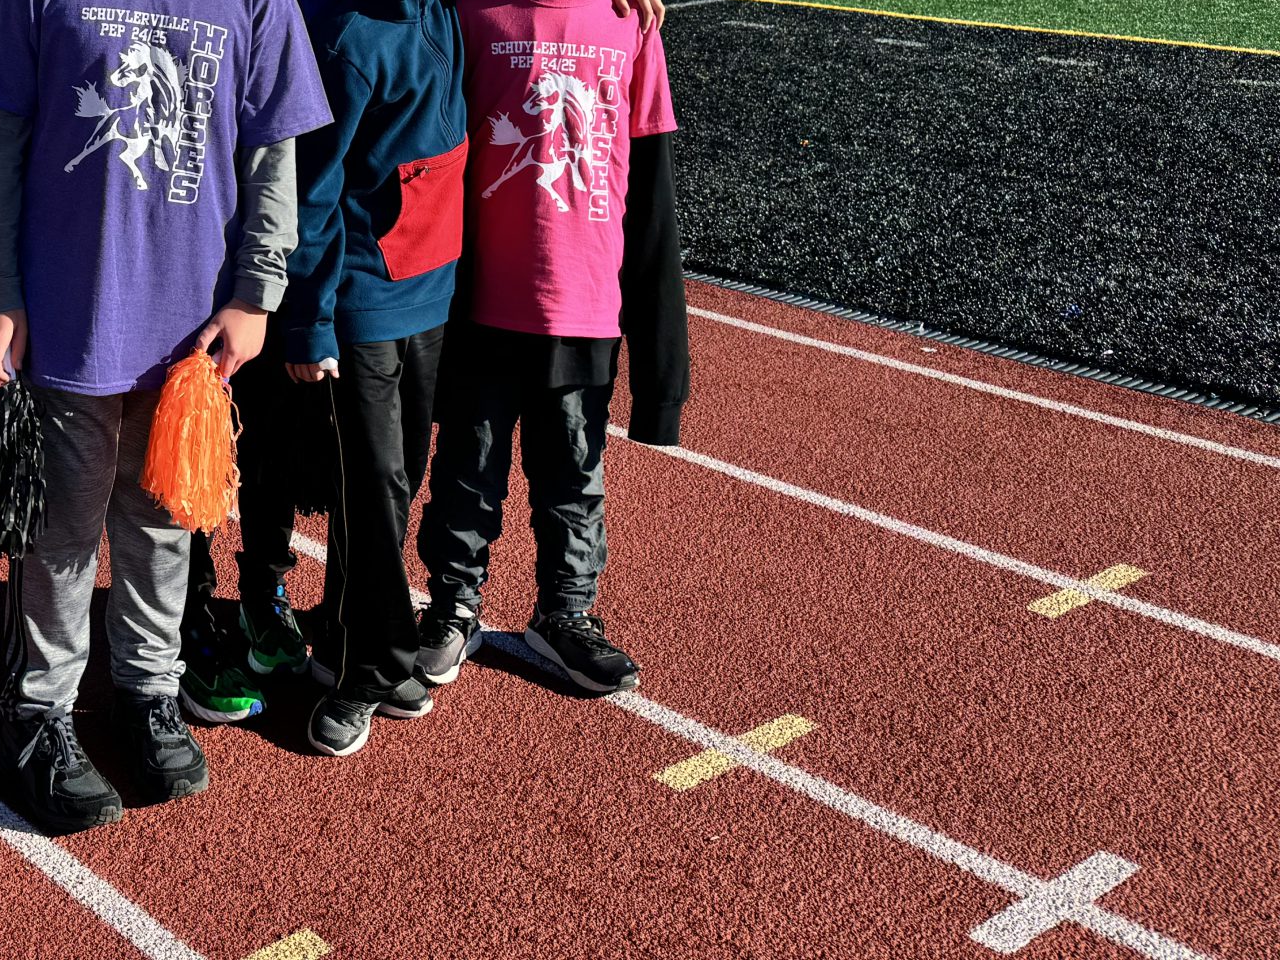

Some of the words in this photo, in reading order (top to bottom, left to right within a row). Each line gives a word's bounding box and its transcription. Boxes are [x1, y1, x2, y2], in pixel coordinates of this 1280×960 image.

[81, 7, 191, 32] SCHUYLERVILLE
[100, 23, 126, 38] PEP
[131, 26, 168, 44] 24/25
[491, 40, 597, 59] SCHUYLERVILLE
[510, 55, 534, 69] PEP
[540, 57, 576, 72] 24/25
[168, 20, 228, 205] HORSES
[588, 47, 627, 222] HORSES
